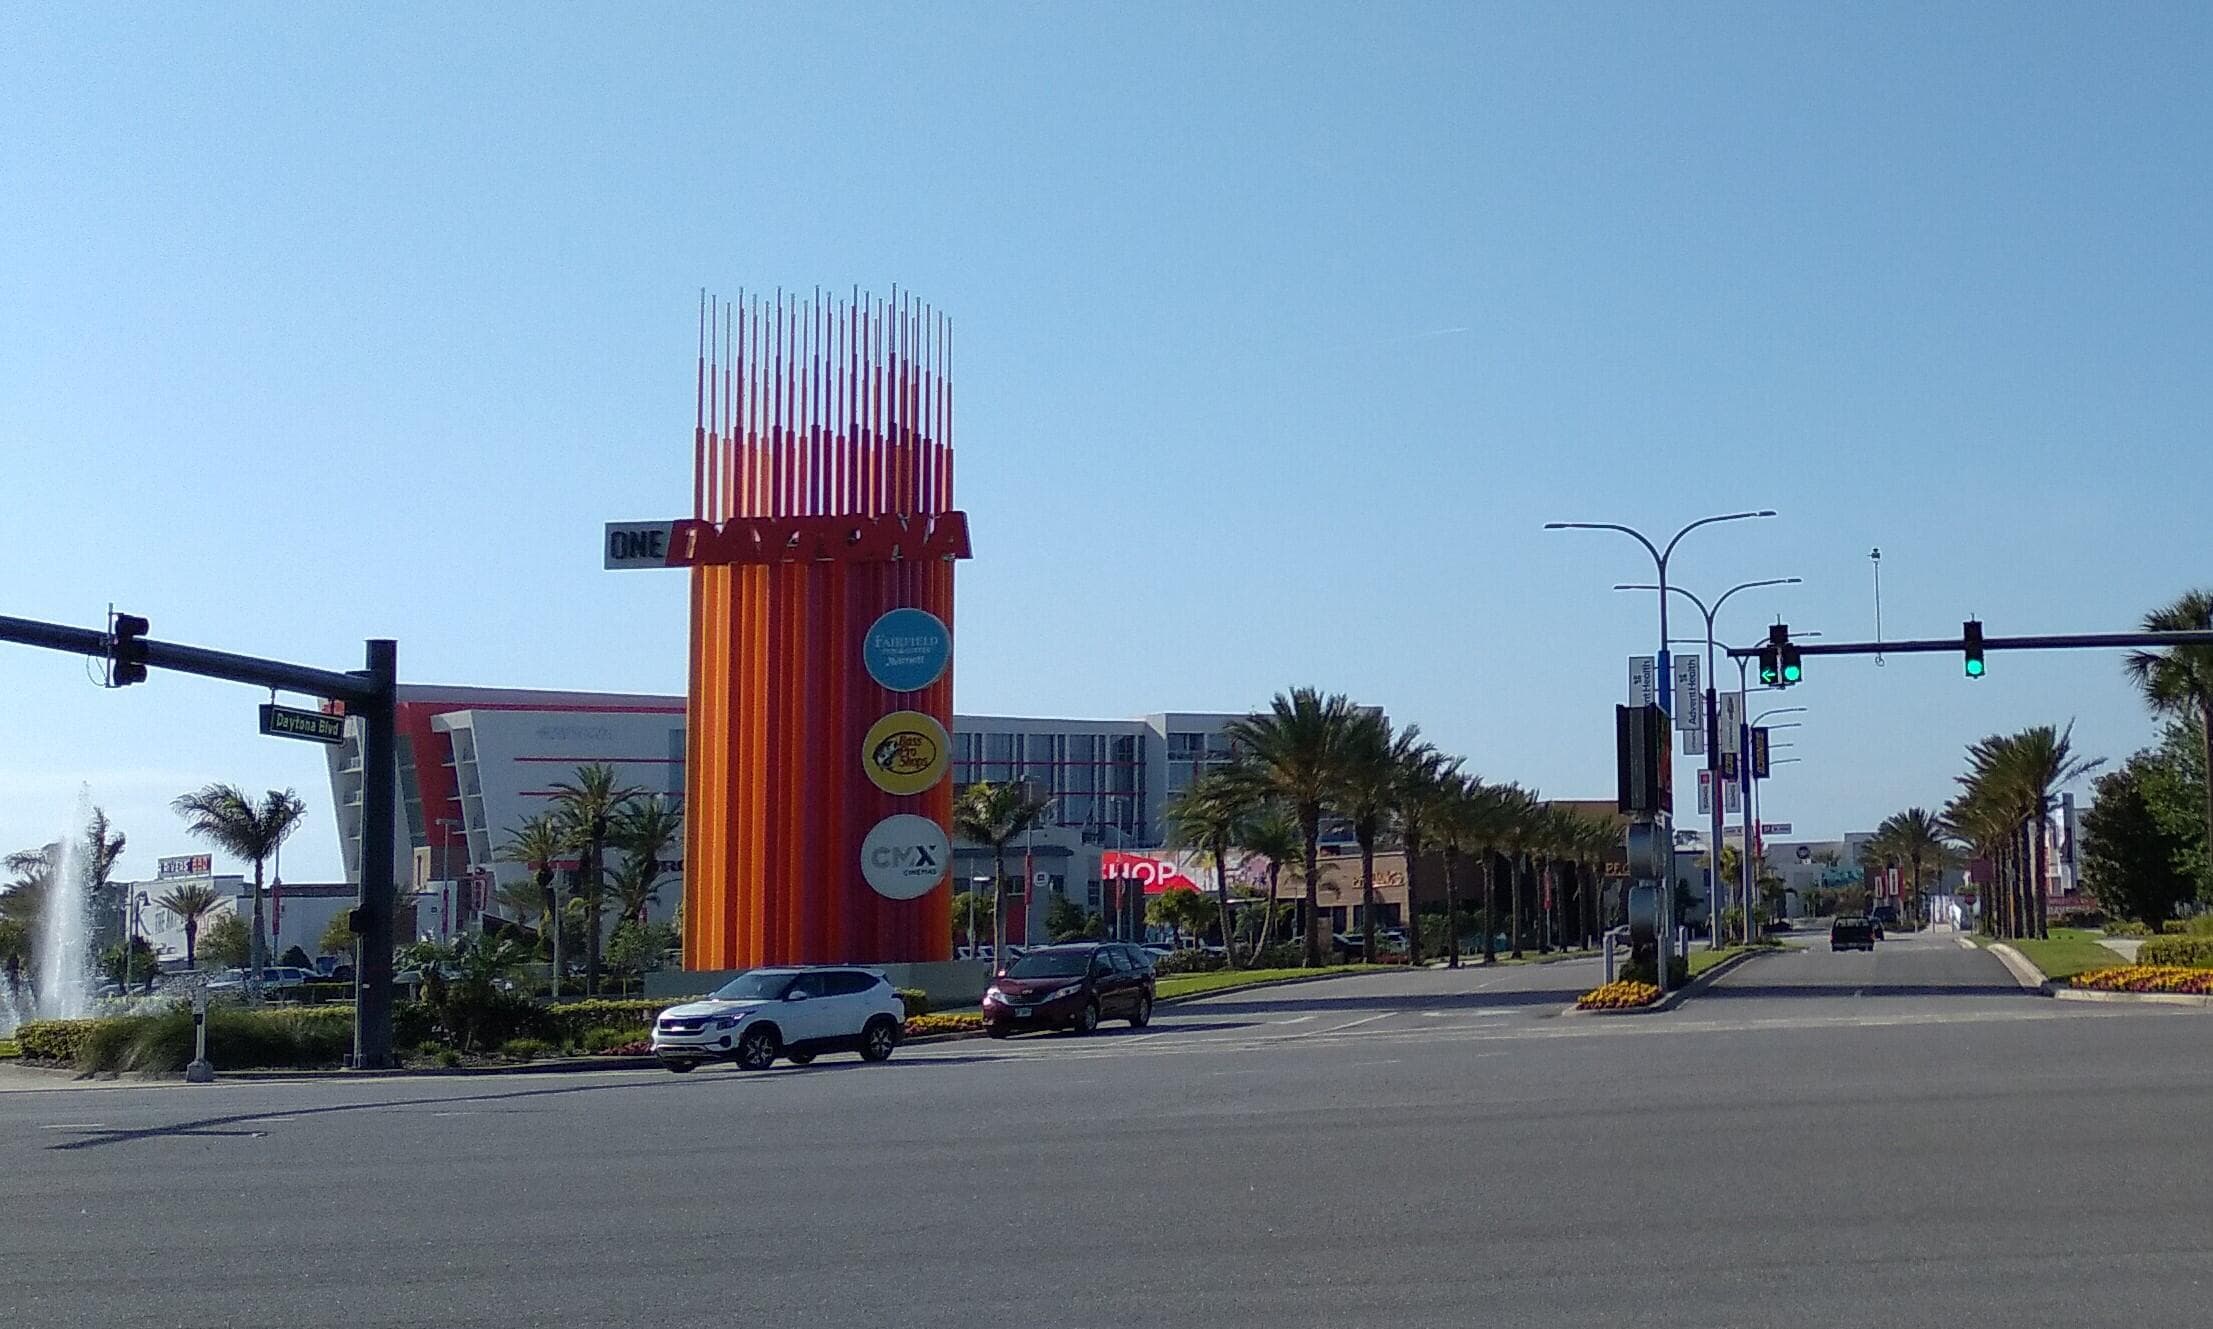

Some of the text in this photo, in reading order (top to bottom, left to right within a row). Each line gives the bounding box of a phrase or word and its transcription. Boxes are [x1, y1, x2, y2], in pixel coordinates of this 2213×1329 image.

[610, 529, 665, 560] ONE
[875, 635, 938, 648] FAIRFIELD
[1688, 659, 1697, 725] AdventHealth
[276, 712, 340, 736] Daytona Blvd
[899, 735, 922, 746] Bass
[898, 757, 928, 769] Shops
[871, 845, 937, 869] CMX
[902, 869, 937, 878] CINEMAS
